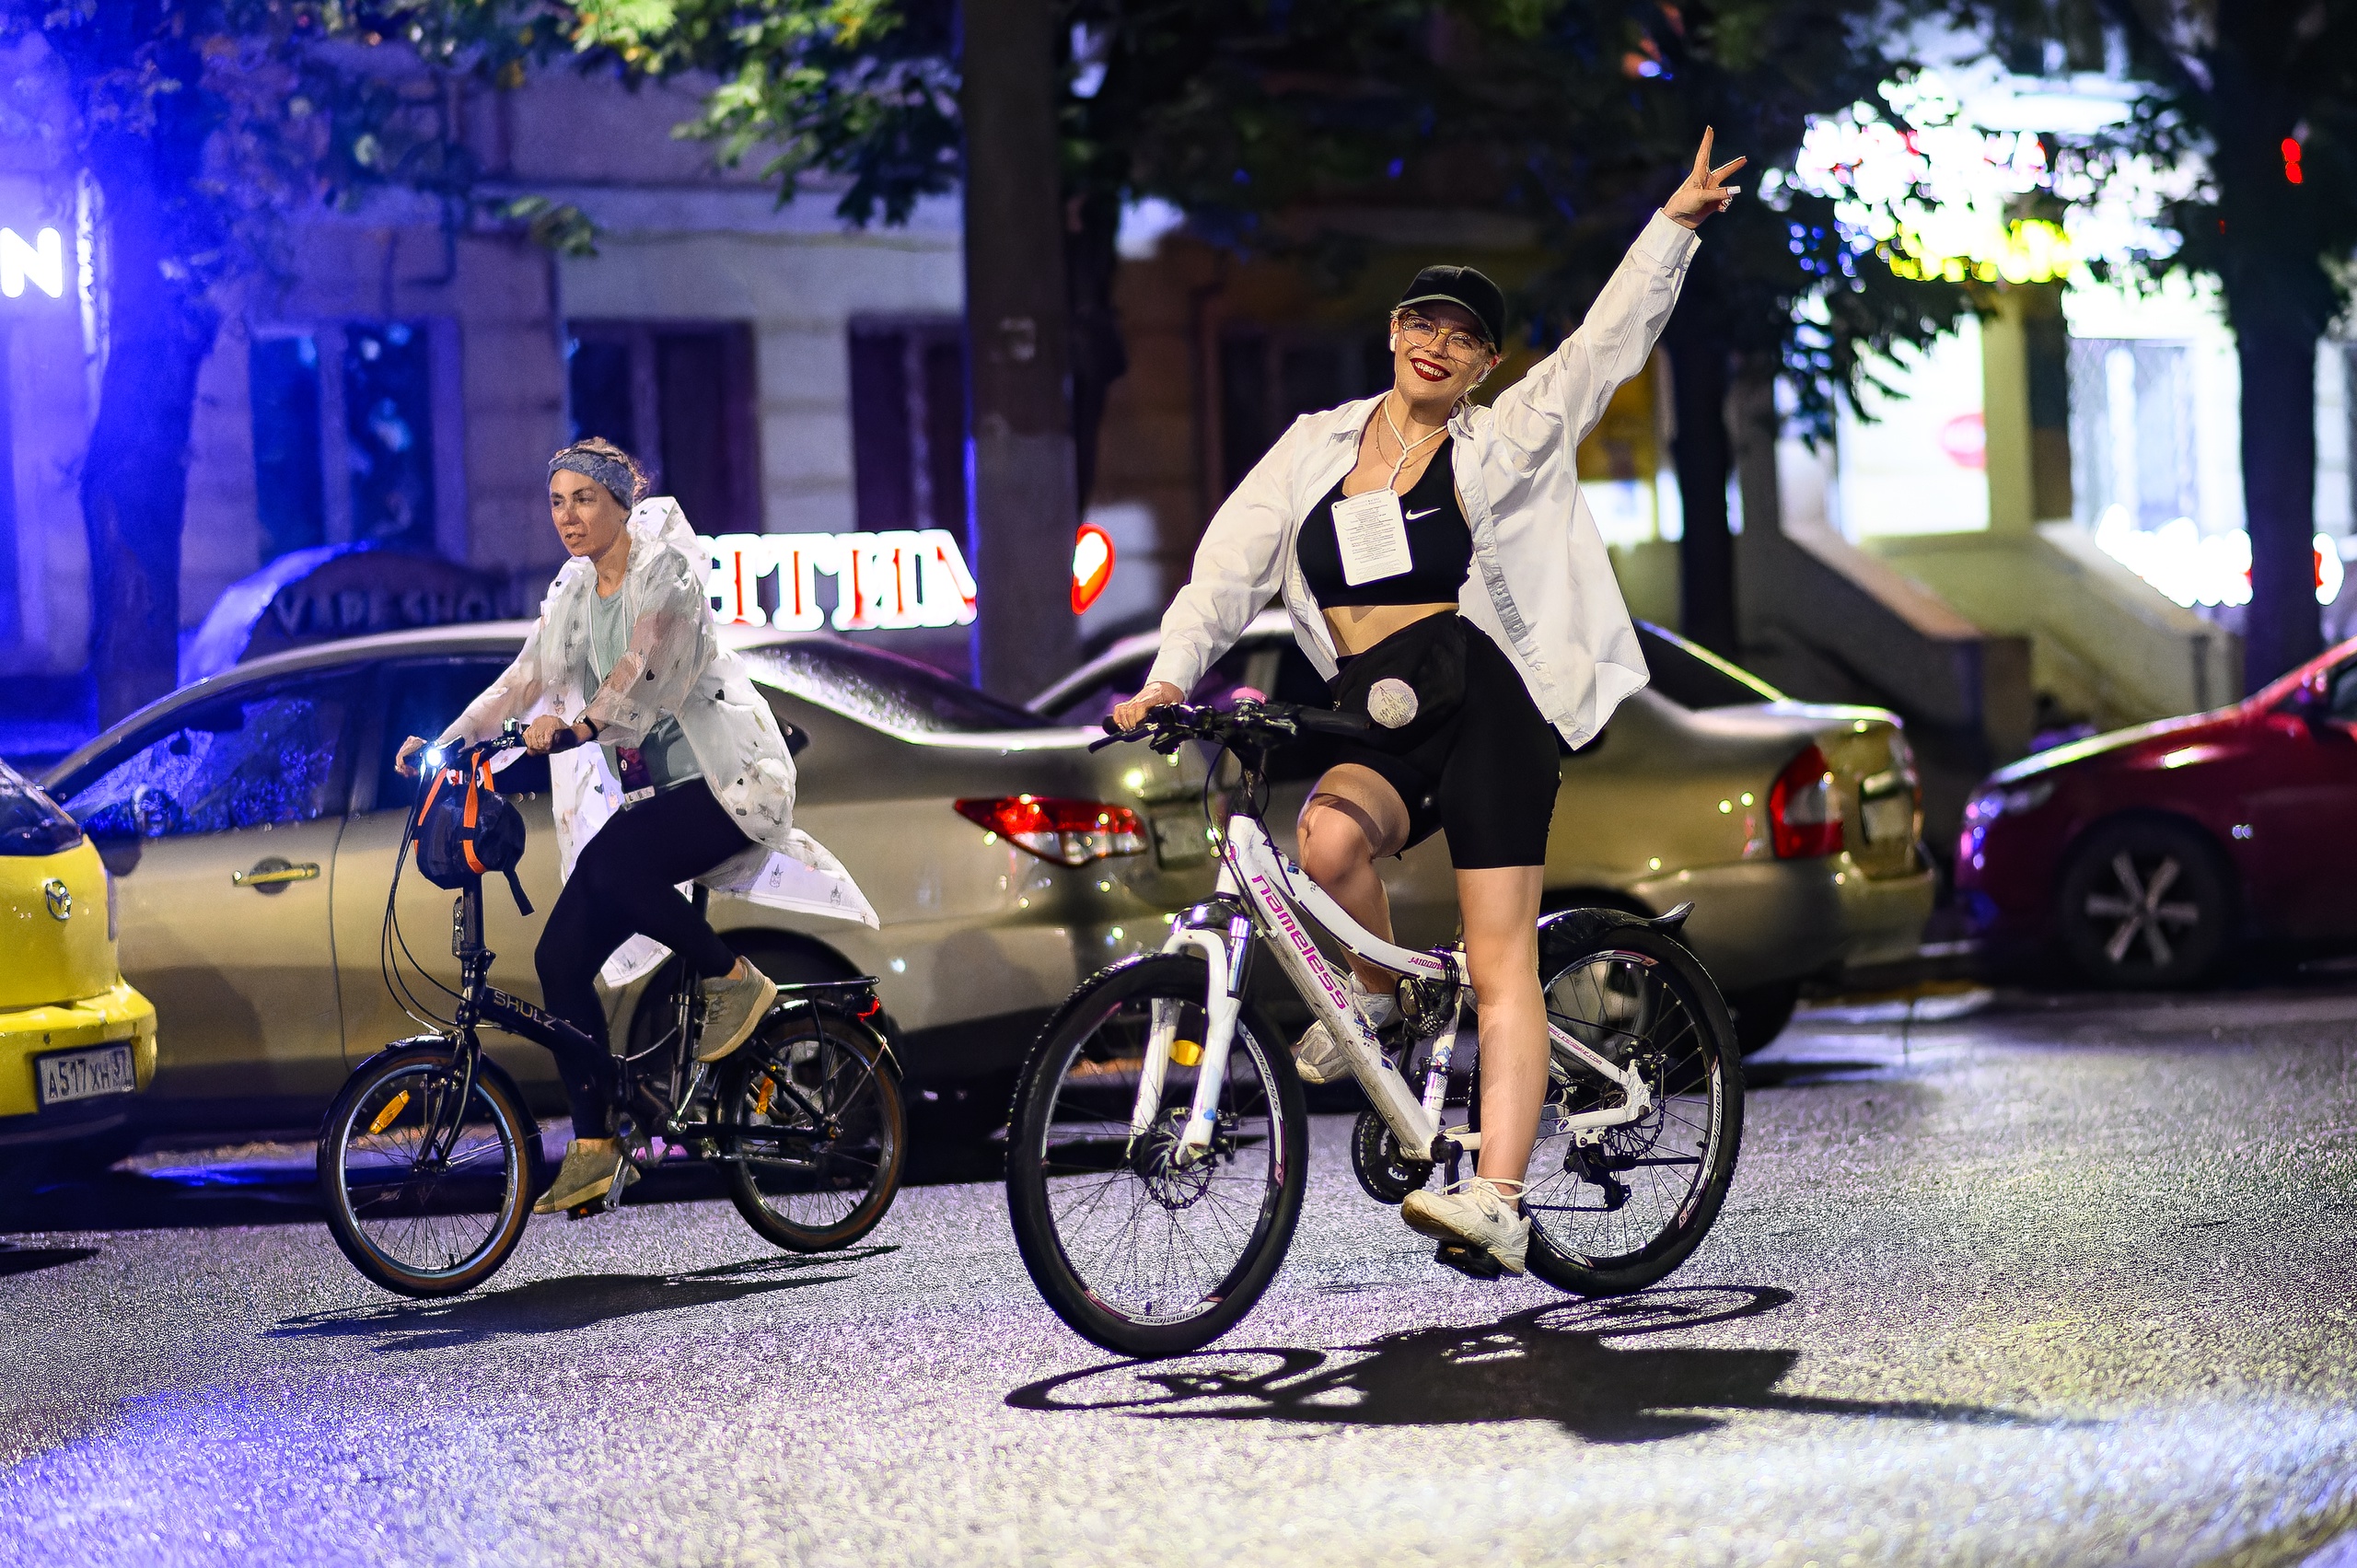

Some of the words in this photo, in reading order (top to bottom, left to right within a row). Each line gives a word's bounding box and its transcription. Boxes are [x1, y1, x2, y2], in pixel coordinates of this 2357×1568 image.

[0, 226, 64, 298] N
[1251, 875, 1350, 1010] nameless
[493, 990, 557, 1031] SHULZ
